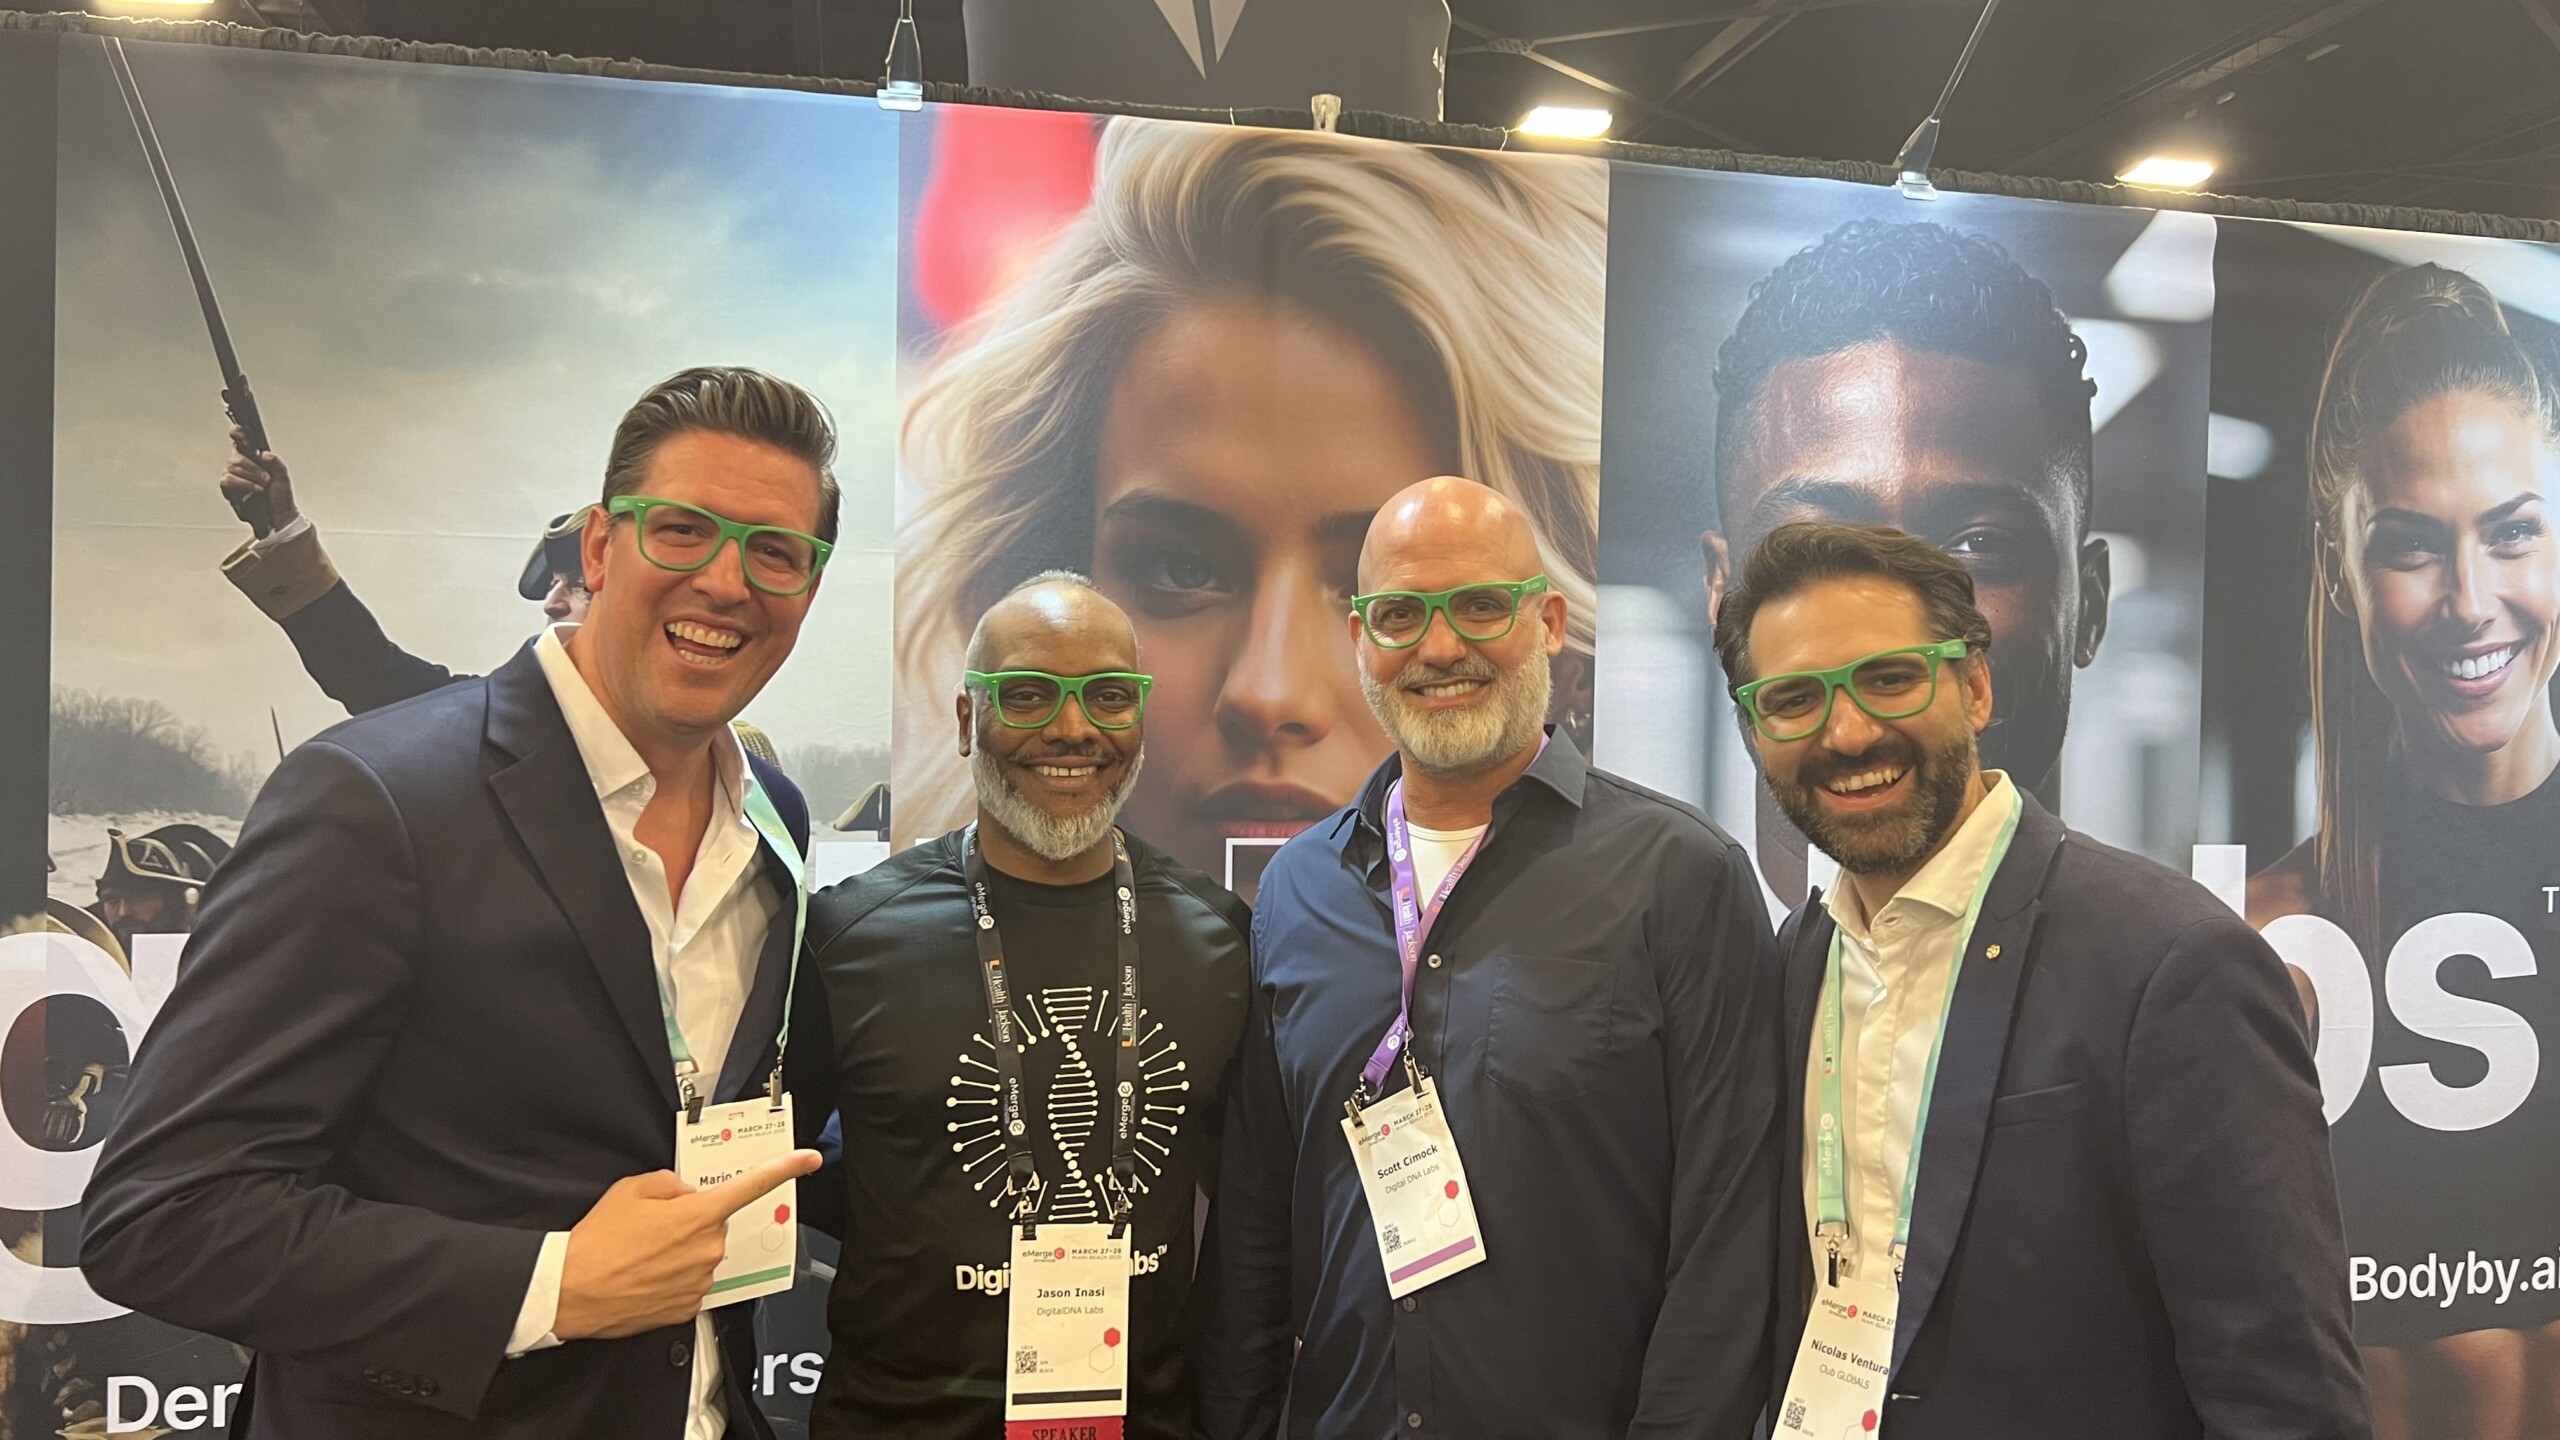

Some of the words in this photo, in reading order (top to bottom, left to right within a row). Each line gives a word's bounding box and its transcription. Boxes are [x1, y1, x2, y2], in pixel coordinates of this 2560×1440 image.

[1403, 929, 1418, 962] Jackson
[1122, 966, 1135, 998] Jackson
[996, 1009, 1012, 1043] Jackson
[1009, 1078, 1020, 1118] eMerge
[738, 1124, 763, 1134] MARCH
[1119, 1098, 1131, 1139] eMerge
[1394, 1112, 1415, 1126] MARCH
[690, 1133, 720, 1144] eMerge
[1358, 1130, 1382, 1146] eMerge
[1377, 1162, 1402, 1180] Scott
[1403, 1144, 1438, 1166] Cimock
[1823, 1130, 1834, 1176] eMerge
[700, 1172, 732, 1186] Mario
[1385, 1178, 1406, 1194] Digital
[1407, 1171, 1423, 1184] DNA
[1423, 1163, 1440, 1176] Labs
[1022, 1250, 1053, 1259] eMerge
[1037, 1289, 1070, 1298] Jason
[1075, 1287, 1106, 1297] Inasi
[1037, 1308, 1082, 1316] DigitalDNA
[1085, 1306, 1104, 1314] Labs
[1822, 1299, 1847, 1314] eMerge
[1862, 1311, 1886, 1322] MARCH
[1811, 1339, 1847, 1360] Nicolas
[1851, 1352, 1890, 1376] Ventura
[752, 1352, 824, 1395] rs
[1819, 1364, 1836, 1377] Club
[1836, 1370, 1871, 1390] GLOBALS
[1032, 1426, 1097, 1440] SPEAKER
